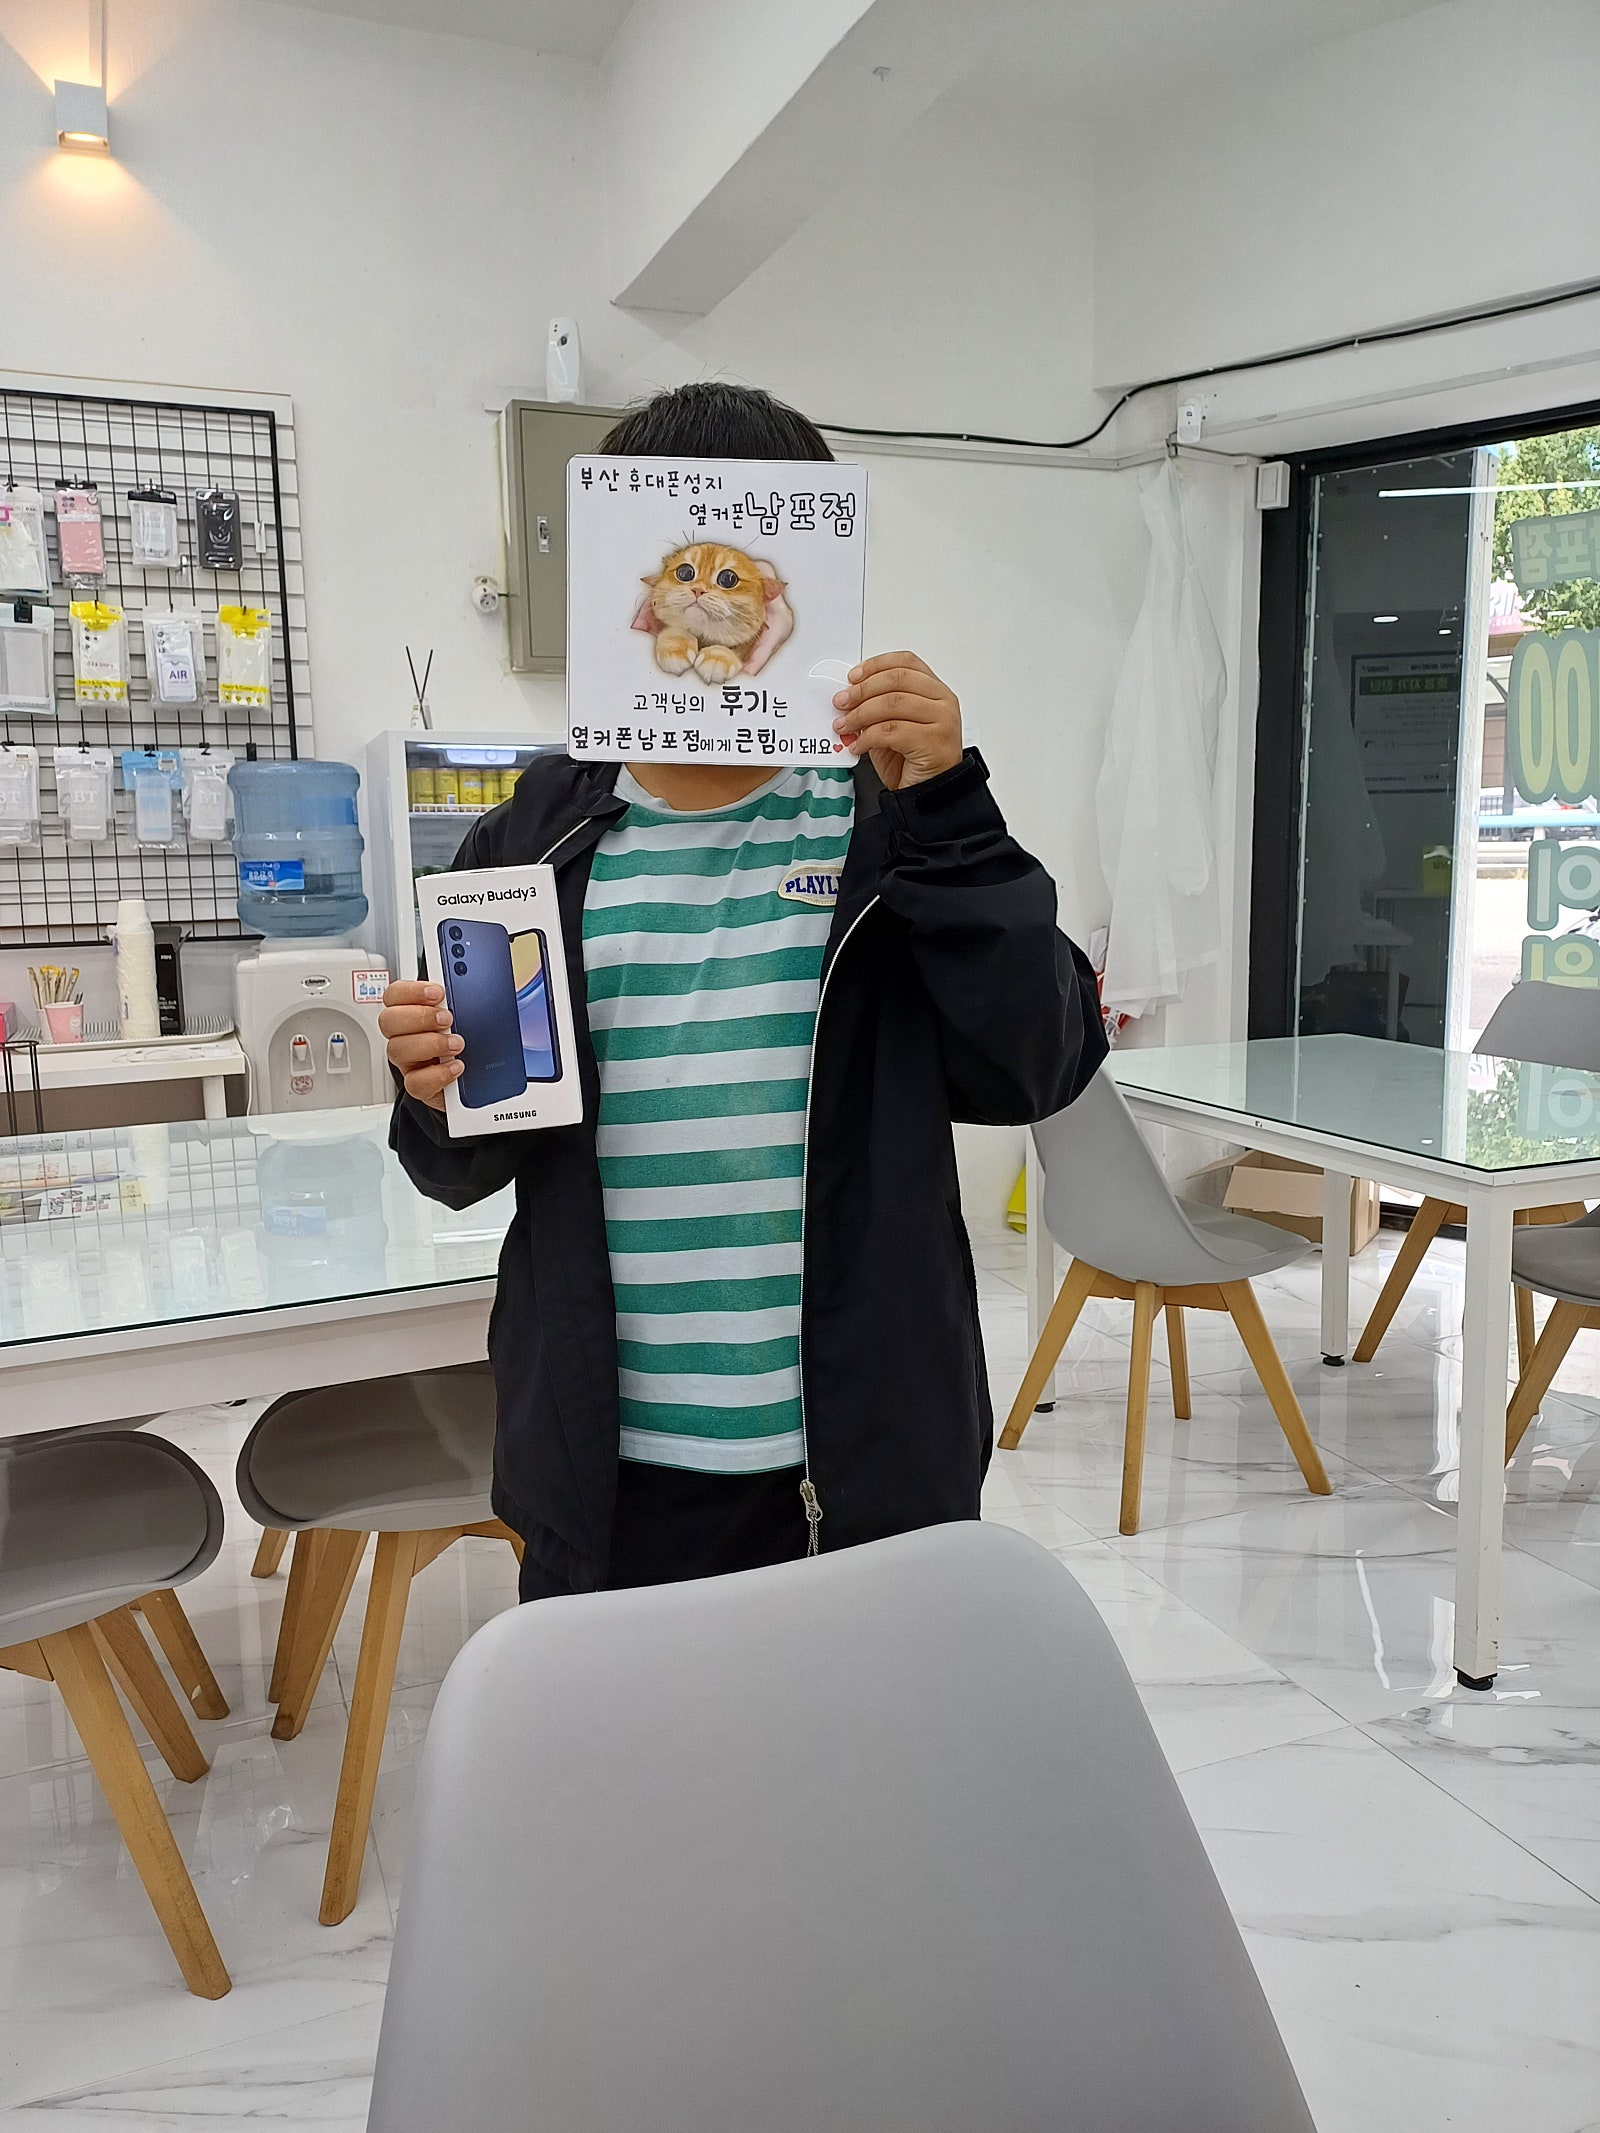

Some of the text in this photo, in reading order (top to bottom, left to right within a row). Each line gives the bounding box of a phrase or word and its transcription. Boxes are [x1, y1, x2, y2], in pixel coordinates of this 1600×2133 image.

[581, 466, 723, 498] 부산 휴대폰성지
[169, 669, 188, 680] AIR
[633, 684, 788, 718] 고객님의 후기는
[799, 738, 833, 755] 돼요
[785, 875, 842, 895] PLAYL
[437, 886, 538, 906] Galaxy Buddy3
[493, 1109, 538, 1122] SAMSUNG
